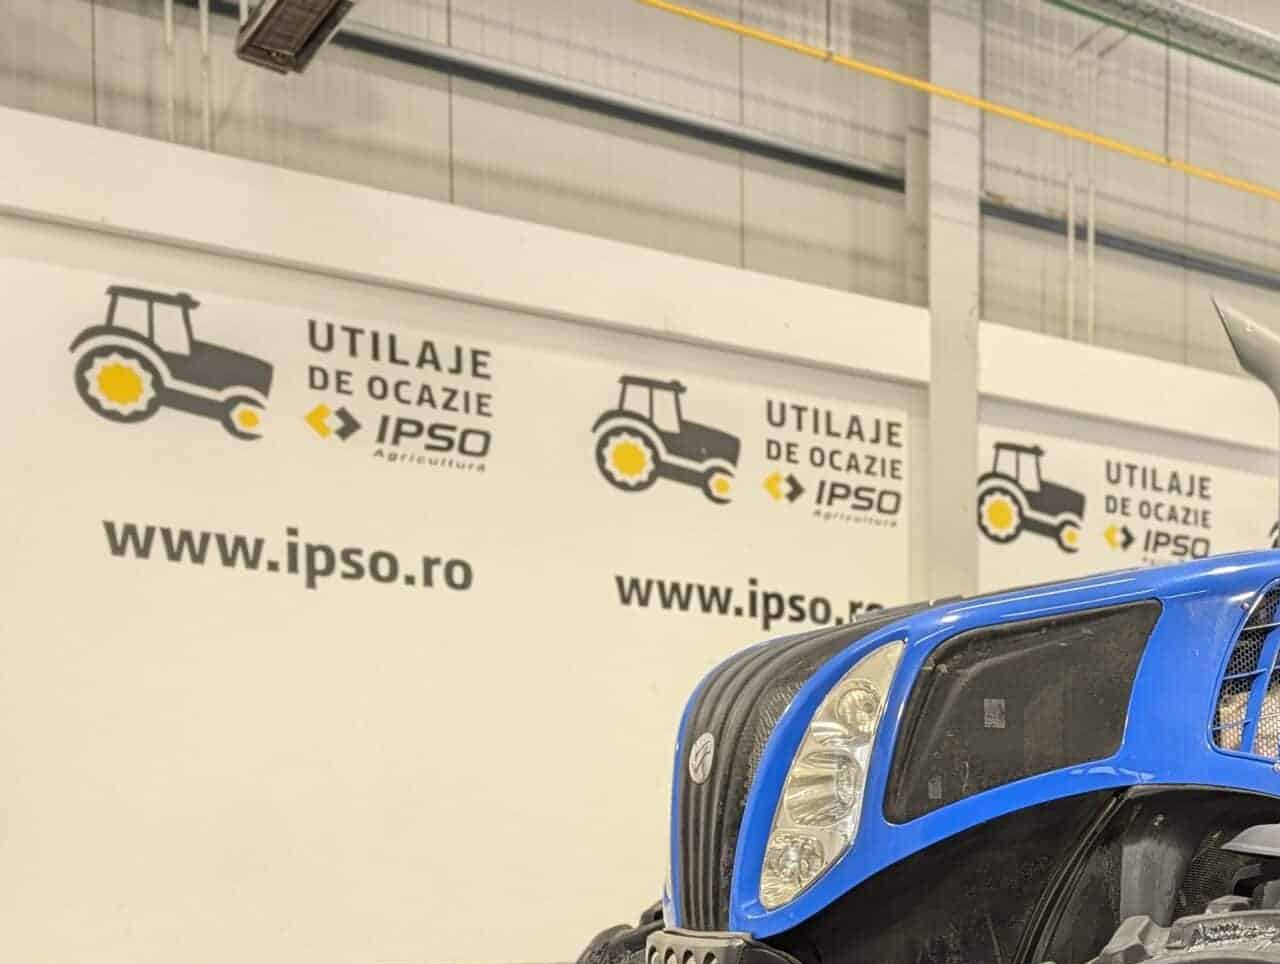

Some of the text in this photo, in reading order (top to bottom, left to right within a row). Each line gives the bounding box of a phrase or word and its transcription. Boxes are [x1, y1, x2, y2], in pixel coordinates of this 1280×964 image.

[308, 319, 492, 380] UTILAJE
[308, 365, 493, 418] DE OCAZIE
[376, 414, 492, 458] IPSO
[766, 399, 903, 448] UTILAJE
[373, 448, 487, 474] Agricultura
[766, 439, 903, 480] DE OCAZIE
[1105, 459, 1212, 500] UTILAJE
[815, 479, 902, 515] IPSO
[1105, 494, 1212, 529] DE OCAZIE
[103, 519, 474, 589] www.ipso.ro
[1143, 529, 1211, 560] IPSO
